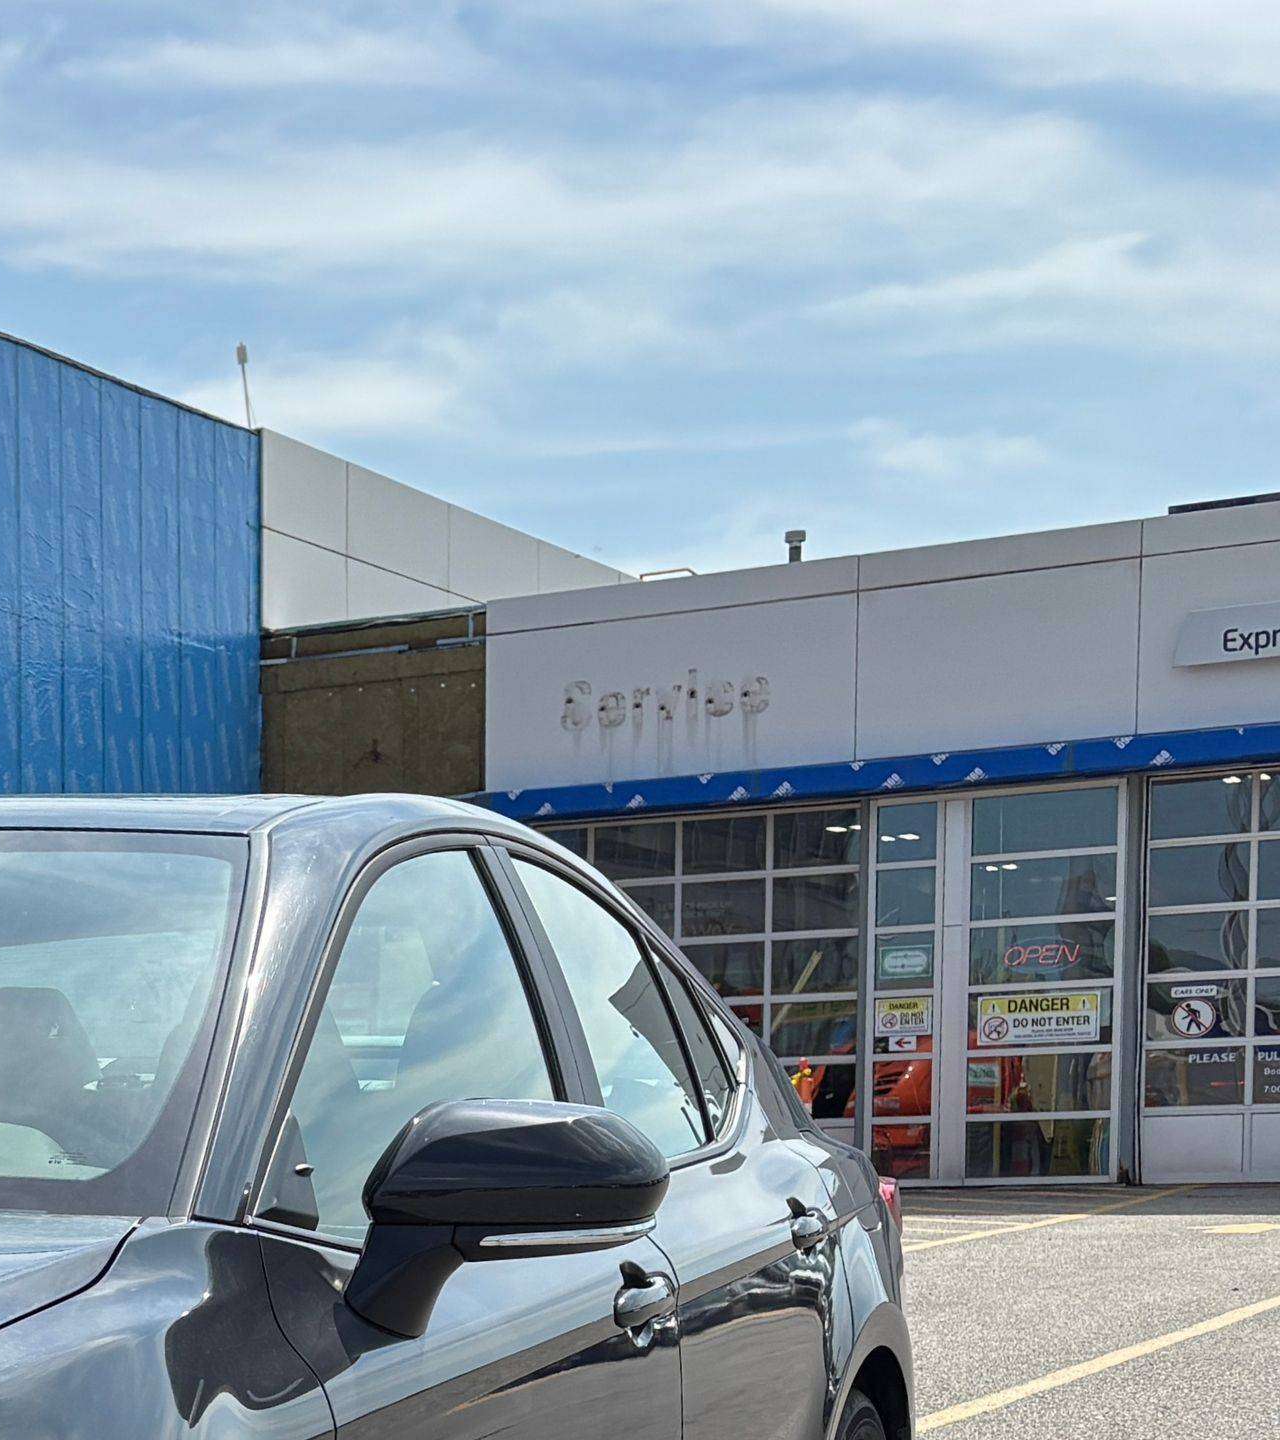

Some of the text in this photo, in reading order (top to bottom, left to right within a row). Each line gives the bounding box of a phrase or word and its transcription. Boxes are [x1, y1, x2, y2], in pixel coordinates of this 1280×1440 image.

[1004, 944, 1081, 968] OPEN
[1007, 997, 1071, 1014] DANGER
[1013, 1015, 1091, 1029] DO NOT ENTER
[1188, 1052, 1238, 1065] PLEASE
